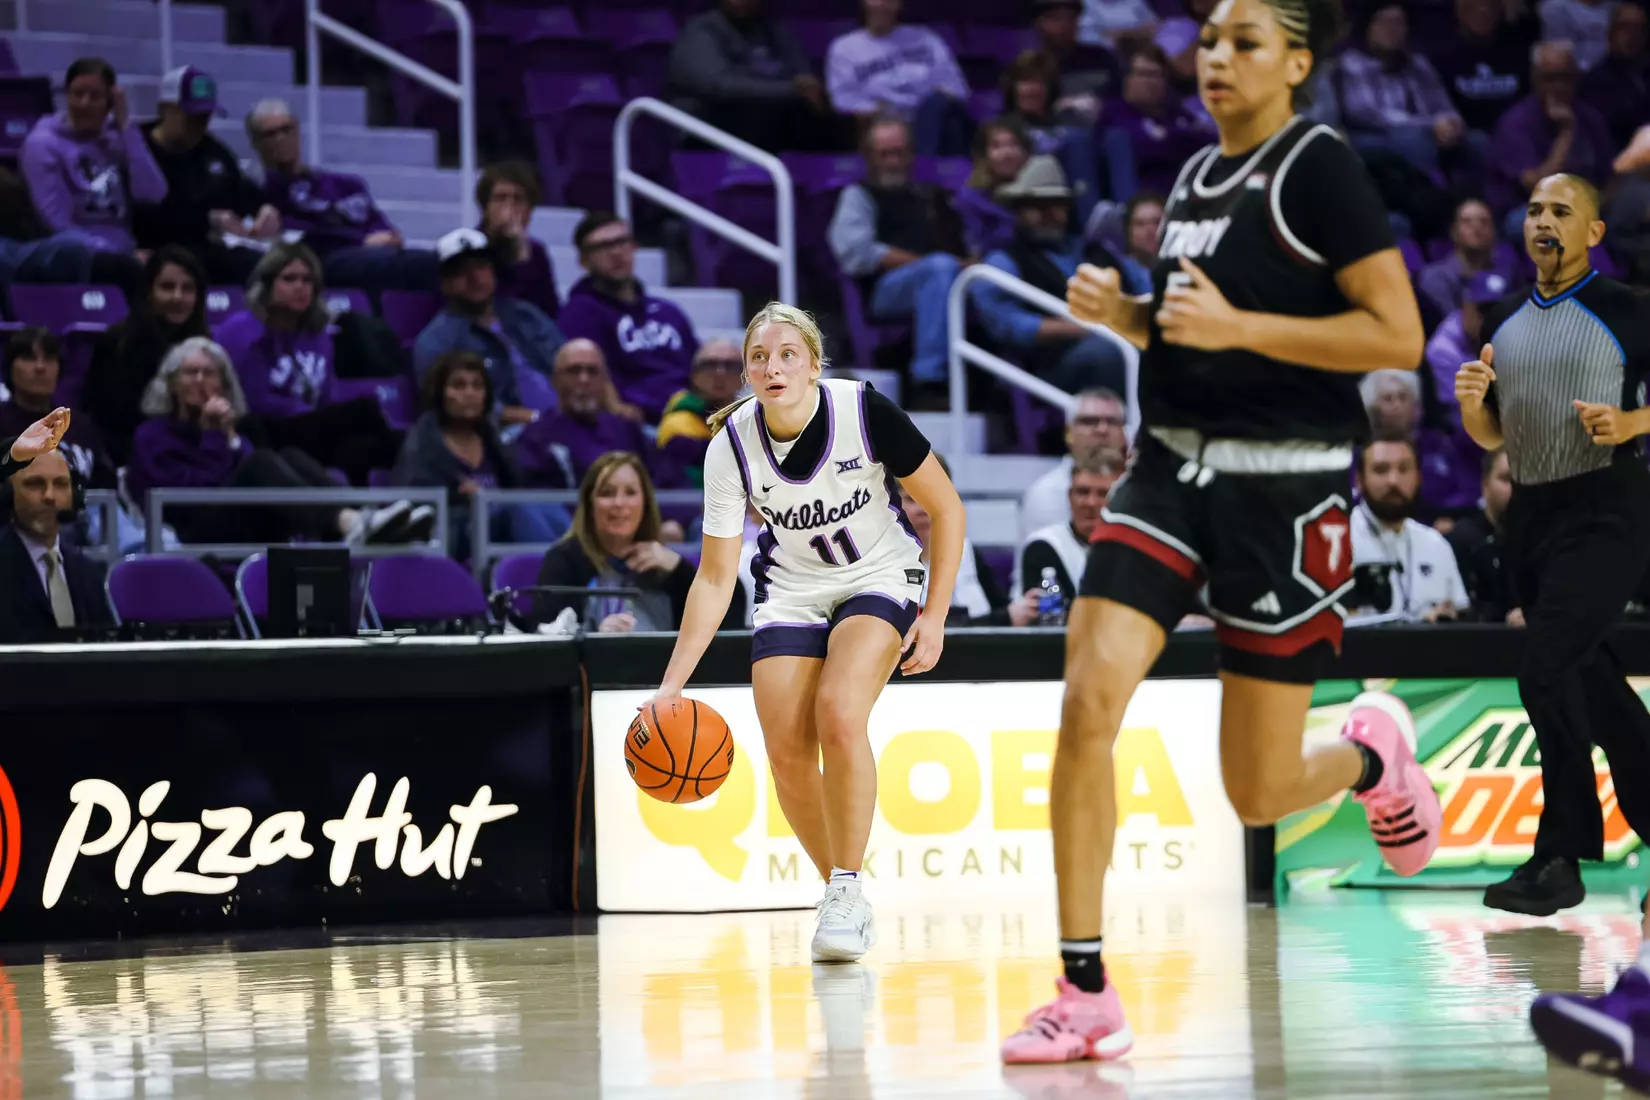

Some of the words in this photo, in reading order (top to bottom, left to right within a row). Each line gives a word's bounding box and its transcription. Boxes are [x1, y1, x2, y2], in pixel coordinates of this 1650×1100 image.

[761, 485, 872, 531] Wildcats
[809, 526, 862, 566] 11
[1320, 523, 1346, 575] T
[42, 778, 315, 910] Pizza
[322, 772, 519, 887] Hut
